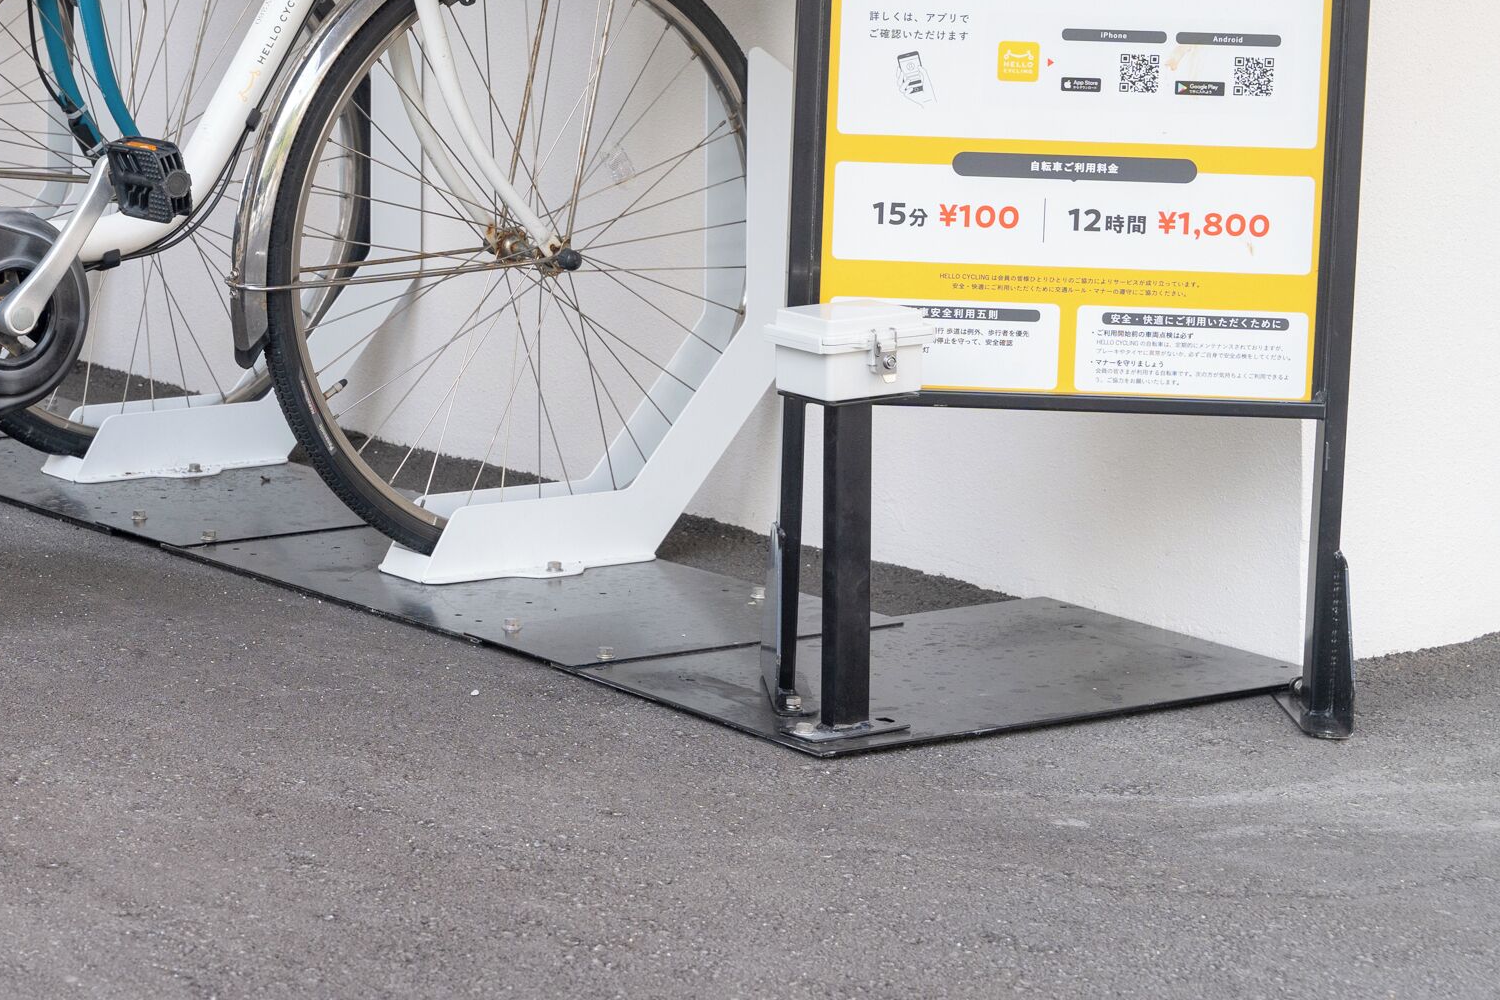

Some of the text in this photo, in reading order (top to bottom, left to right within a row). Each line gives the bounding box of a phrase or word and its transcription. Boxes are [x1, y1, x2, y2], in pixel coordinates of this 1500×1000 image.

[869, 10, 970, 24] 詳しくは、アプリで
[869, 28, 969, 41] ご確認いただけます
[1100, 31, 1128, 40] iPhone
[1212, 35, 1244, 44] Android
[257, 25, 283, 65] HELLO
[1003, 61, 1034, 69] HELLO
[1073, 79, 1085, 87] App
[1189, 83, 1219, 92] Google Play
[1030, 160, 1119, 175] 自転車ご利用料金
[872, 201, 1020, 229] 15分 ¥100
[1067, 208, 1270, 240] 12時間 ¥1,800
[961, 273, 990, 281] CYCLING
[1110, 313, 1282, 329] 安全・快適にご利用いただくために
